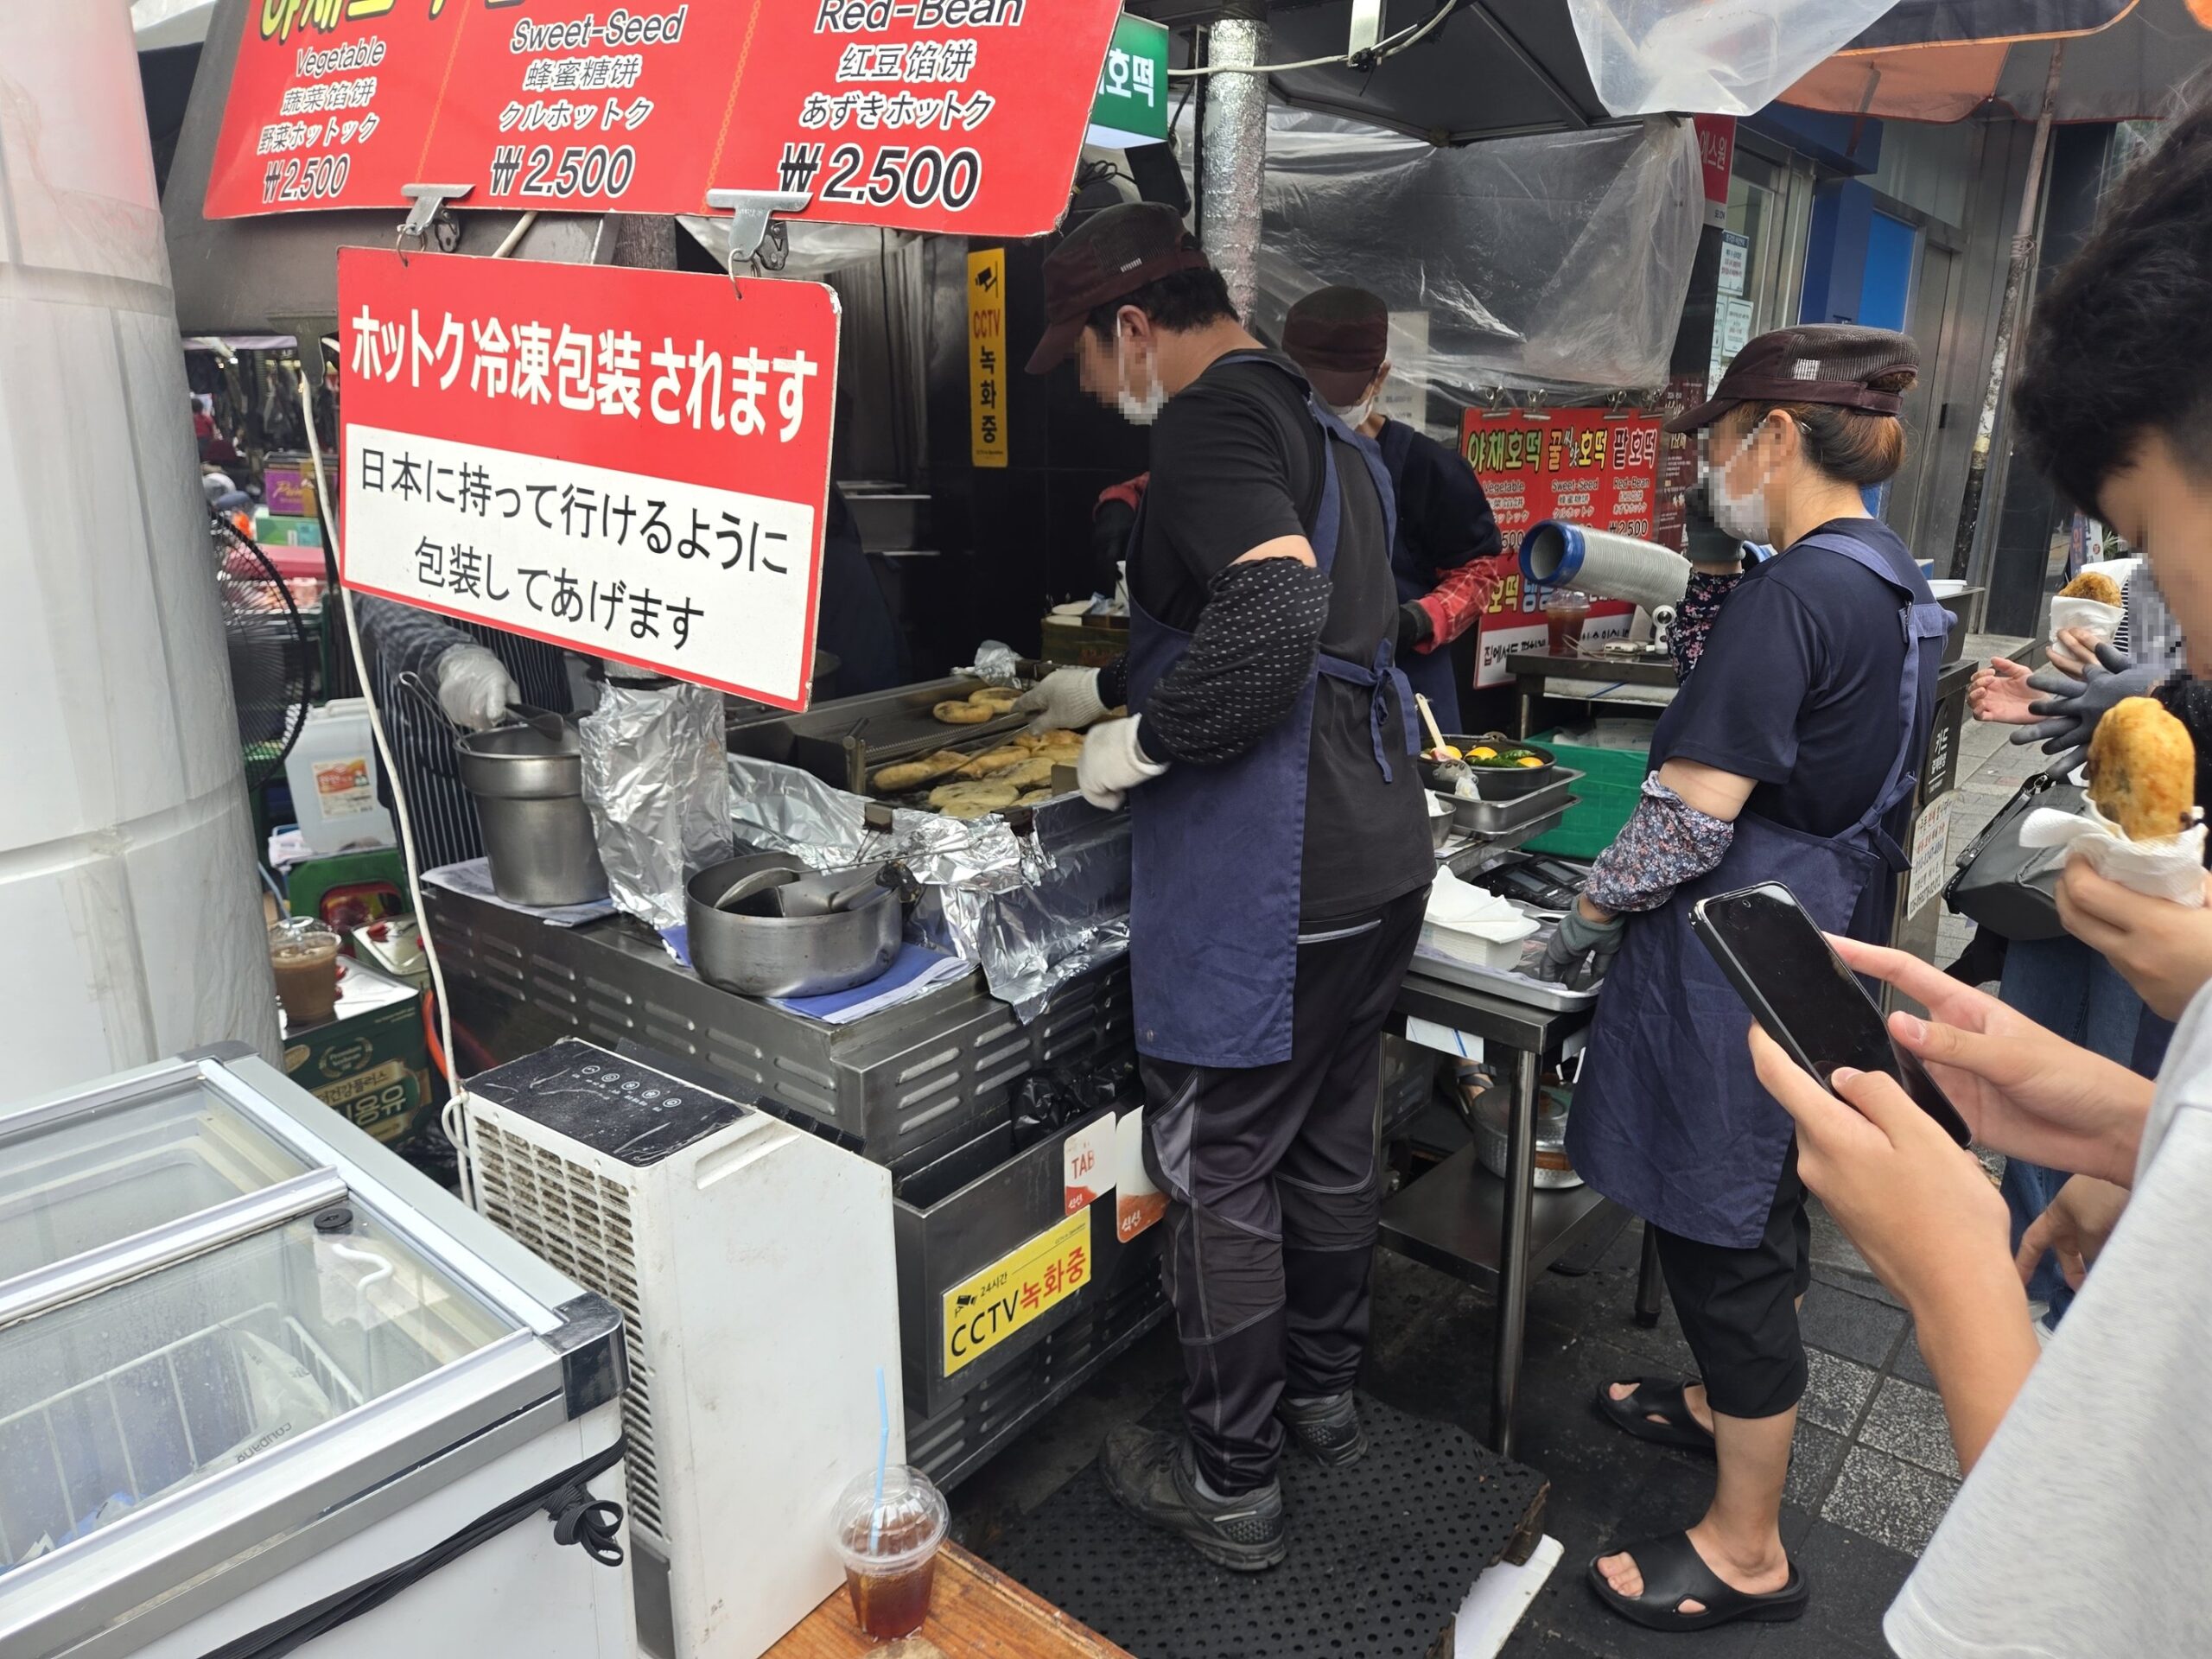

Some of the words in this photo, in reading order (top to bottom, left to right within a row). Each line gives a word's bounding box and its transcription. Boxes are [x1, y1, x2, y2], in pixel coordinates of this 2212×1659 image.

[512, 7, 686, 51] Sweet-Seed
[817, 0, 1021, 31] Red-Bean
[296, 38, 385, 77] Vegetable
[525, 56, 639, 90] 蜂蜜糖饼
[838, 41, 975, 80] 红豆馅饼
[282, 79, 373, 113] 蔬菜馅饼
[1098, 48, 1154, 109] 호떡
[499, 99, 652, 131] クルホットク
[801, 94, 993, 129] あずきホットク
[259, 114, 378, 154] 野菜ホットック
[973, 308, 1001, 339] CCTV
[1469, 429, 1542, 473] 야채호떡
[1613, 428, 1656, 470] 팥호떡
[1613, 477, 1649, 489] Red-Bean
[360, 448, 788, 575] 日本に持って行けるように
[415, 535, 705, 650] 包装してあげます
[1935, 727, 1949, 754] 카드
[346, 1084, 407, 1127] 용유
[1071, 1150, 1095, 1179] TAB
[980, 1272, 1008, 1297] 24시간
